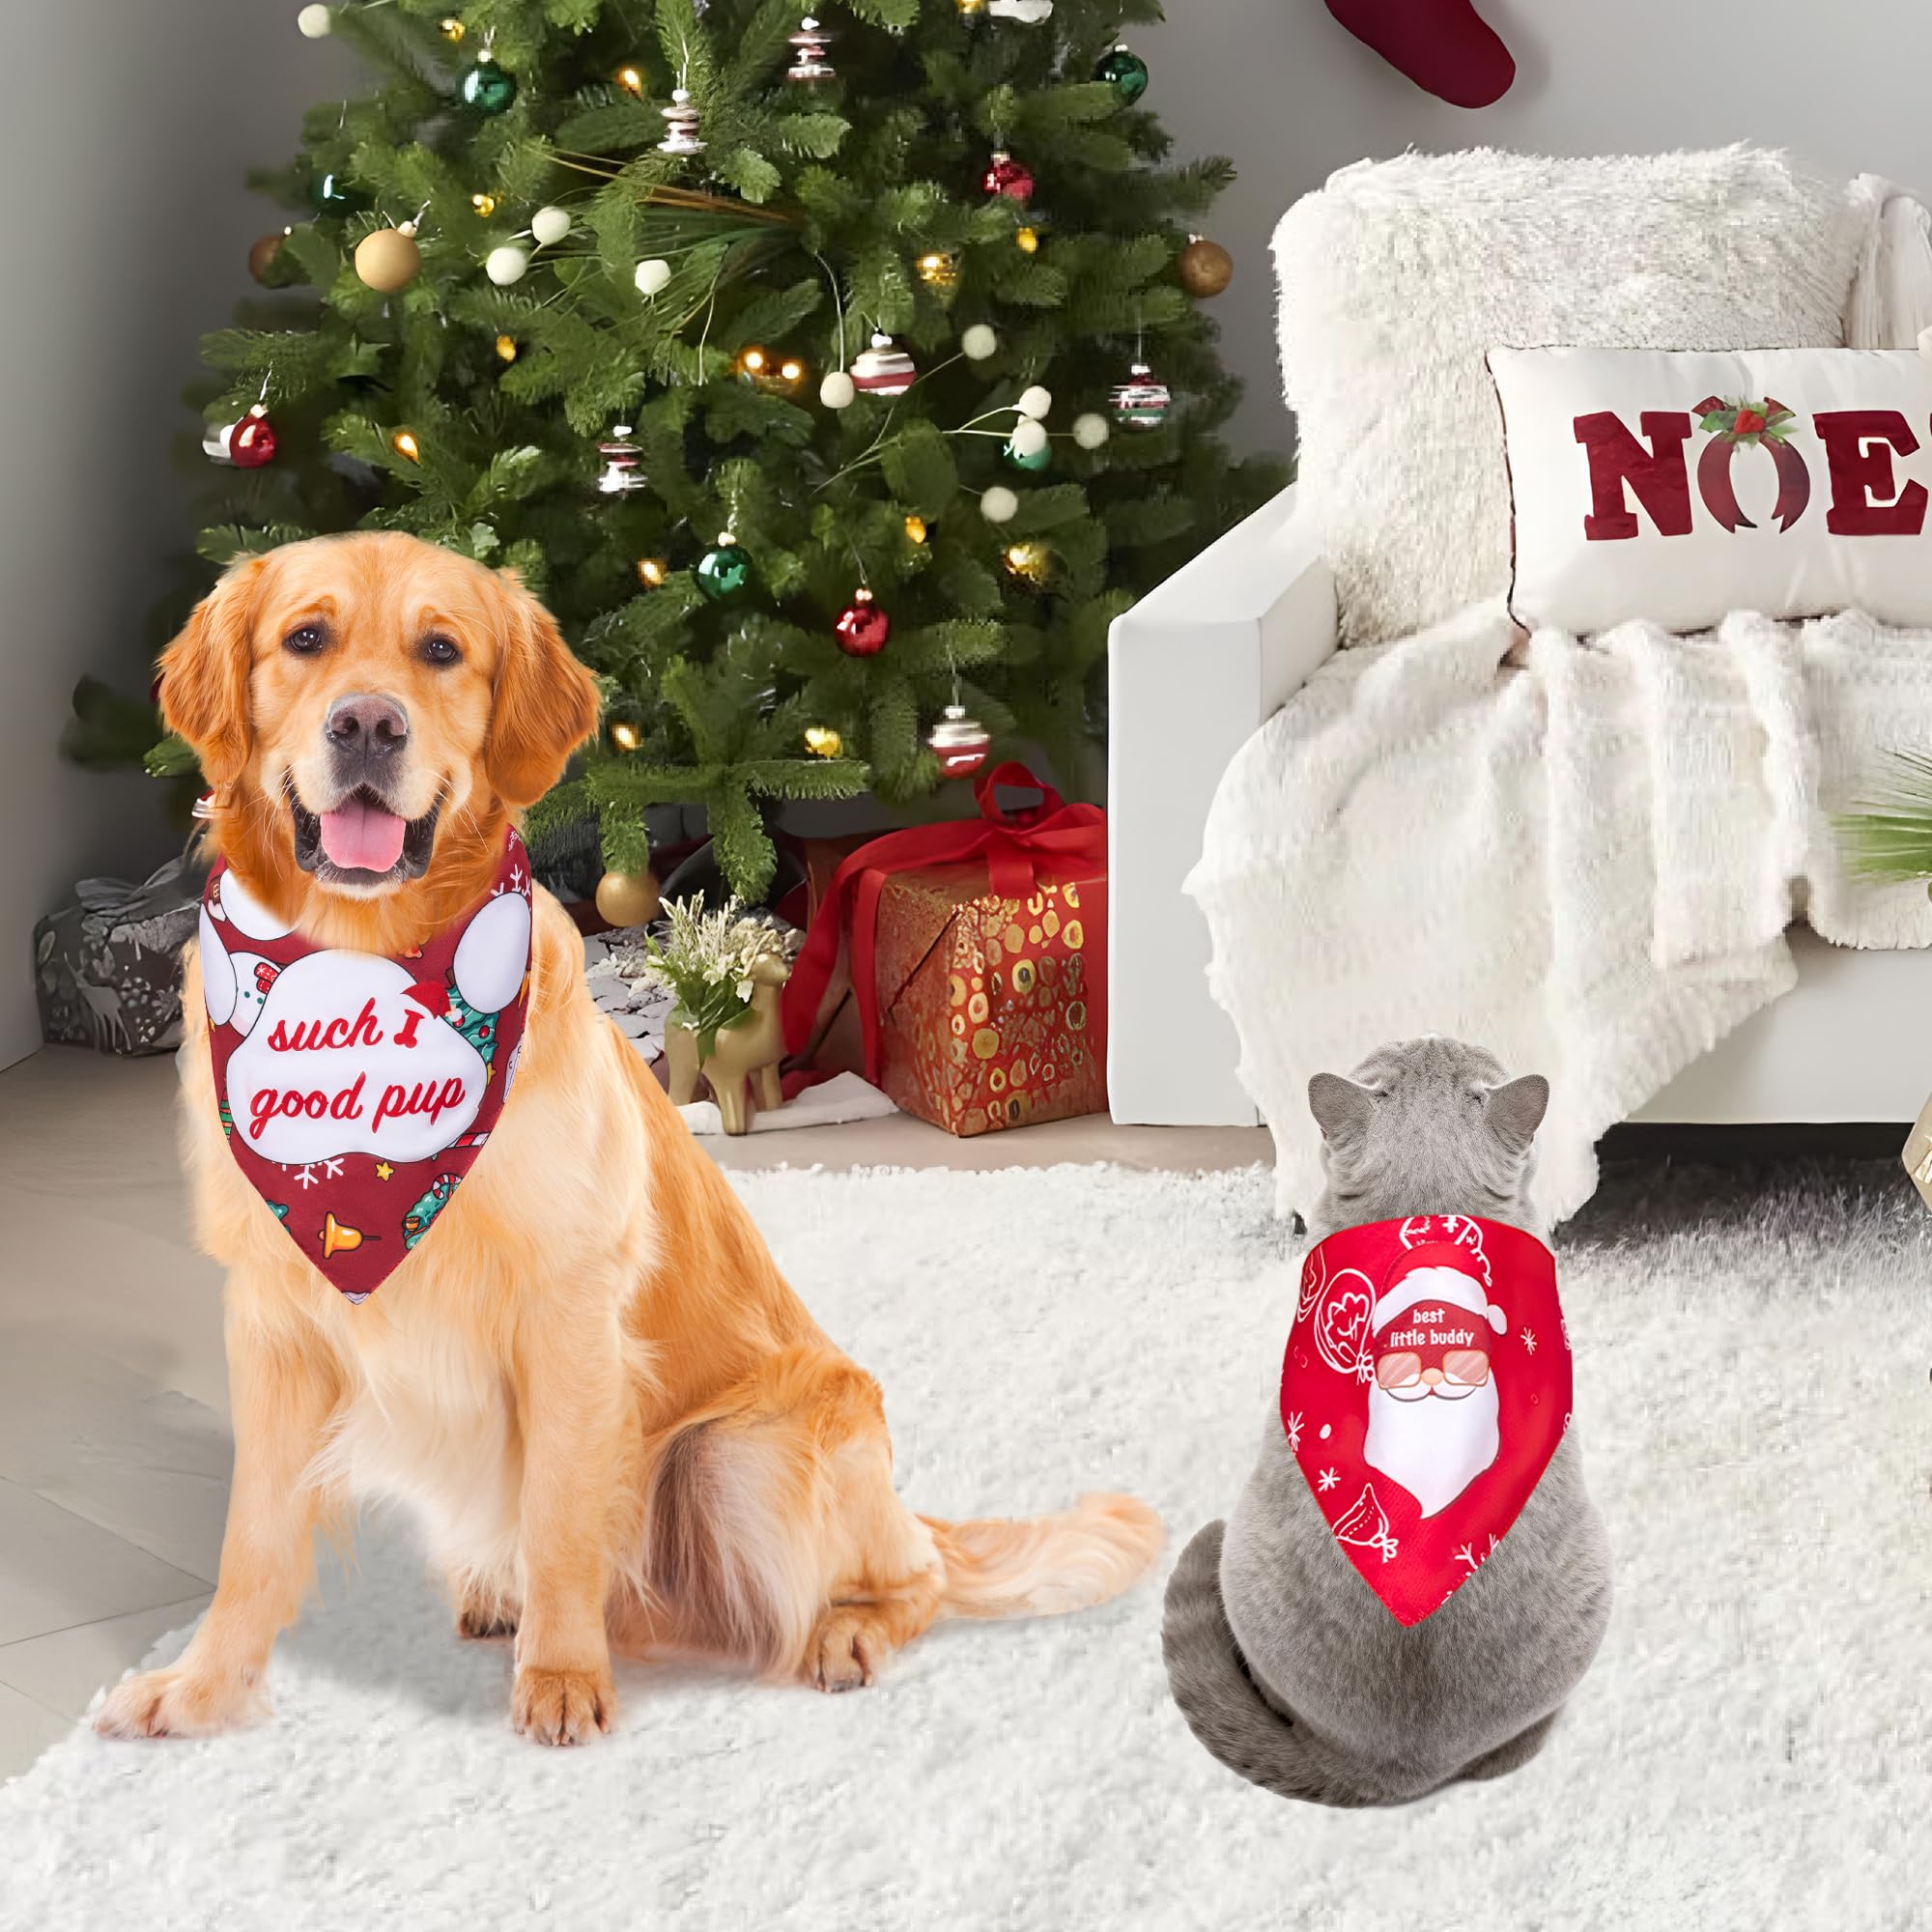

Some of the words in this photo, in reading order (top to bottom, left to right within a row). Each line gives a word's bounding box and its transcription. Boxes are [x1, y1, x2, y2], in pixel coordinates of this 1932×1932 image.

[1573, 398, 1932, 541] NOE
[267, 996, 384, 1052] such
[248, 1070, 367, 1141] good
[371, 1077, 467, 1134] pup
[1390, 1328, 1426, 1348] little
[1430, 1328, 1475, 1347] buddy
[1412, 1308, 1446, 1324] best
